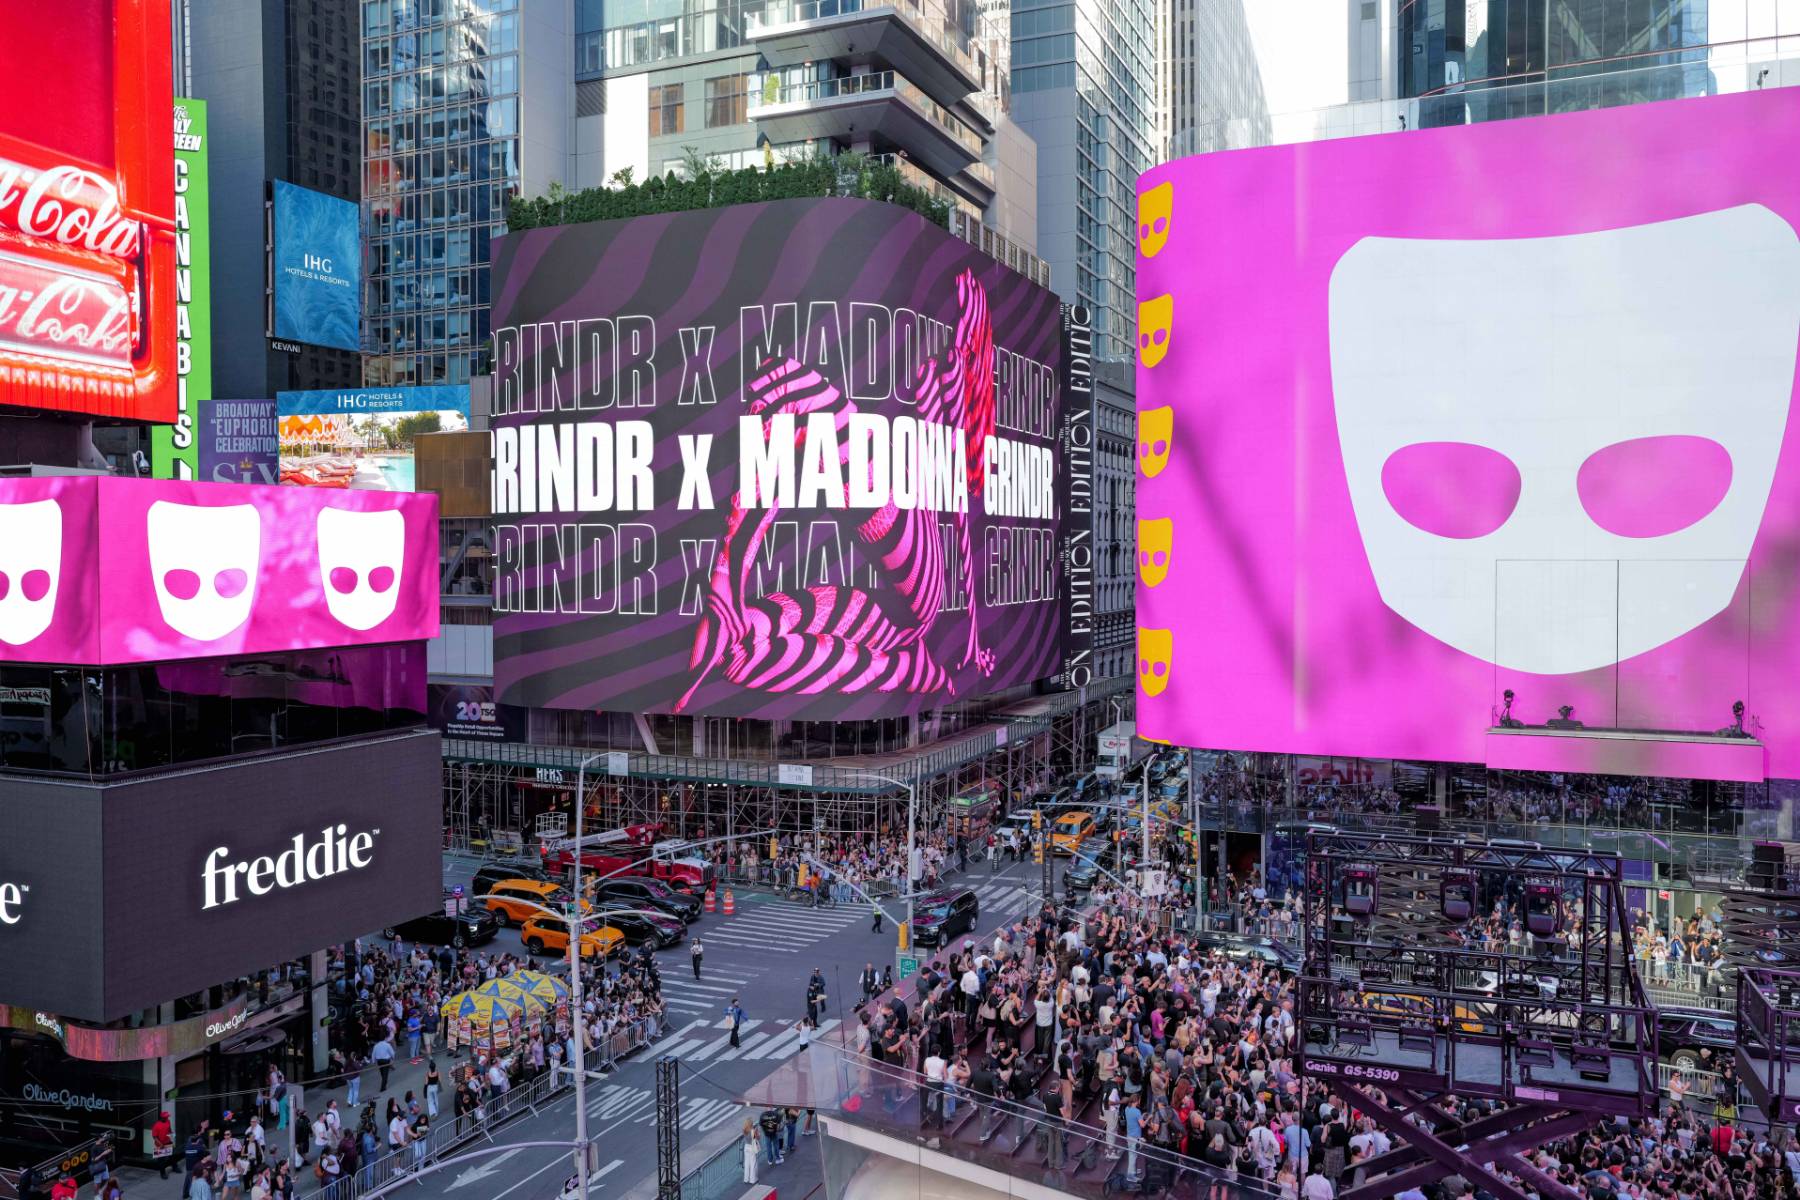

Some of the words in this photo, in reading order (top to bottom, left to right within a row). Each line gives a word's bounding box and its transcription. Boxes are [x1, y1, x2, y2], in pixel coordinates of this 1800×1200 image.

[285, 267, 313, 279] HOTELS
[320, 274, 350, 287] RESORTS
[304, 253, 332, 273] IHG
[172, 159, 192, 448] CANNABIS
[337, 394, 366, 408] IHG
[368, 400, 403, 408] RESORTS
[740, 412, 969, 513] MADONNA
[984, 434, 1054, 520] GRINDR
[1071, 407, 1091, 513] EDITION
[984, 525, 1055, 607] GRINDR
[1071, 528, 1091, 634] EDITION
[201, 823, 373, 910] freddie
[206, 1020, 232, 1037] Olive
[1305, 1060, 1337, 1073] Genie
[1344, 1065, 1399, 1081] GS-5390
[23, 1083, 58, 1101] Olive
[59, 1088, 114, 1111] Garden
